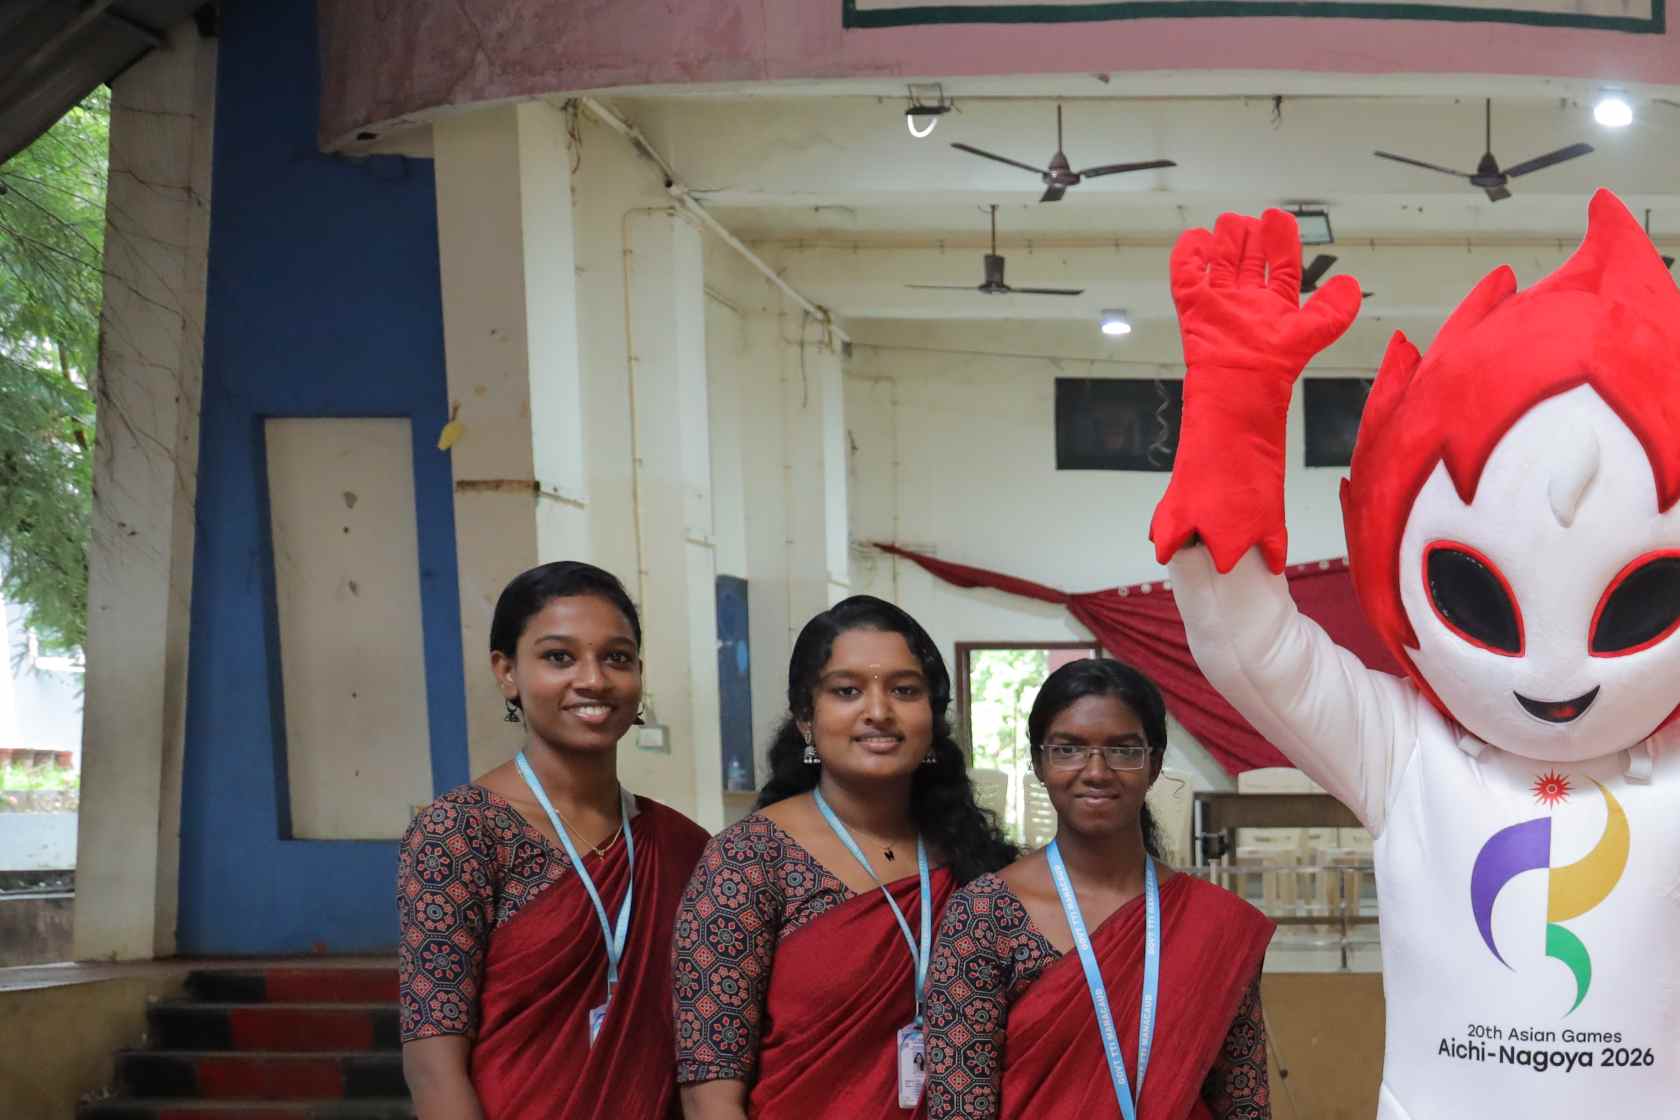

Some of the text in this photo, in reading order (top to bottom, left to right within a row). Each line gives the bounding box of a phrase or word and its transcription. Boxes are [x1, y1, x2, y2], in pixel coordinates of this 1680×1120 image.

[1466, 1024, 1622, 1043] 20th Asian Games
[1438, 1038, 1655, 1073] Aichi-Nagoya 2026
